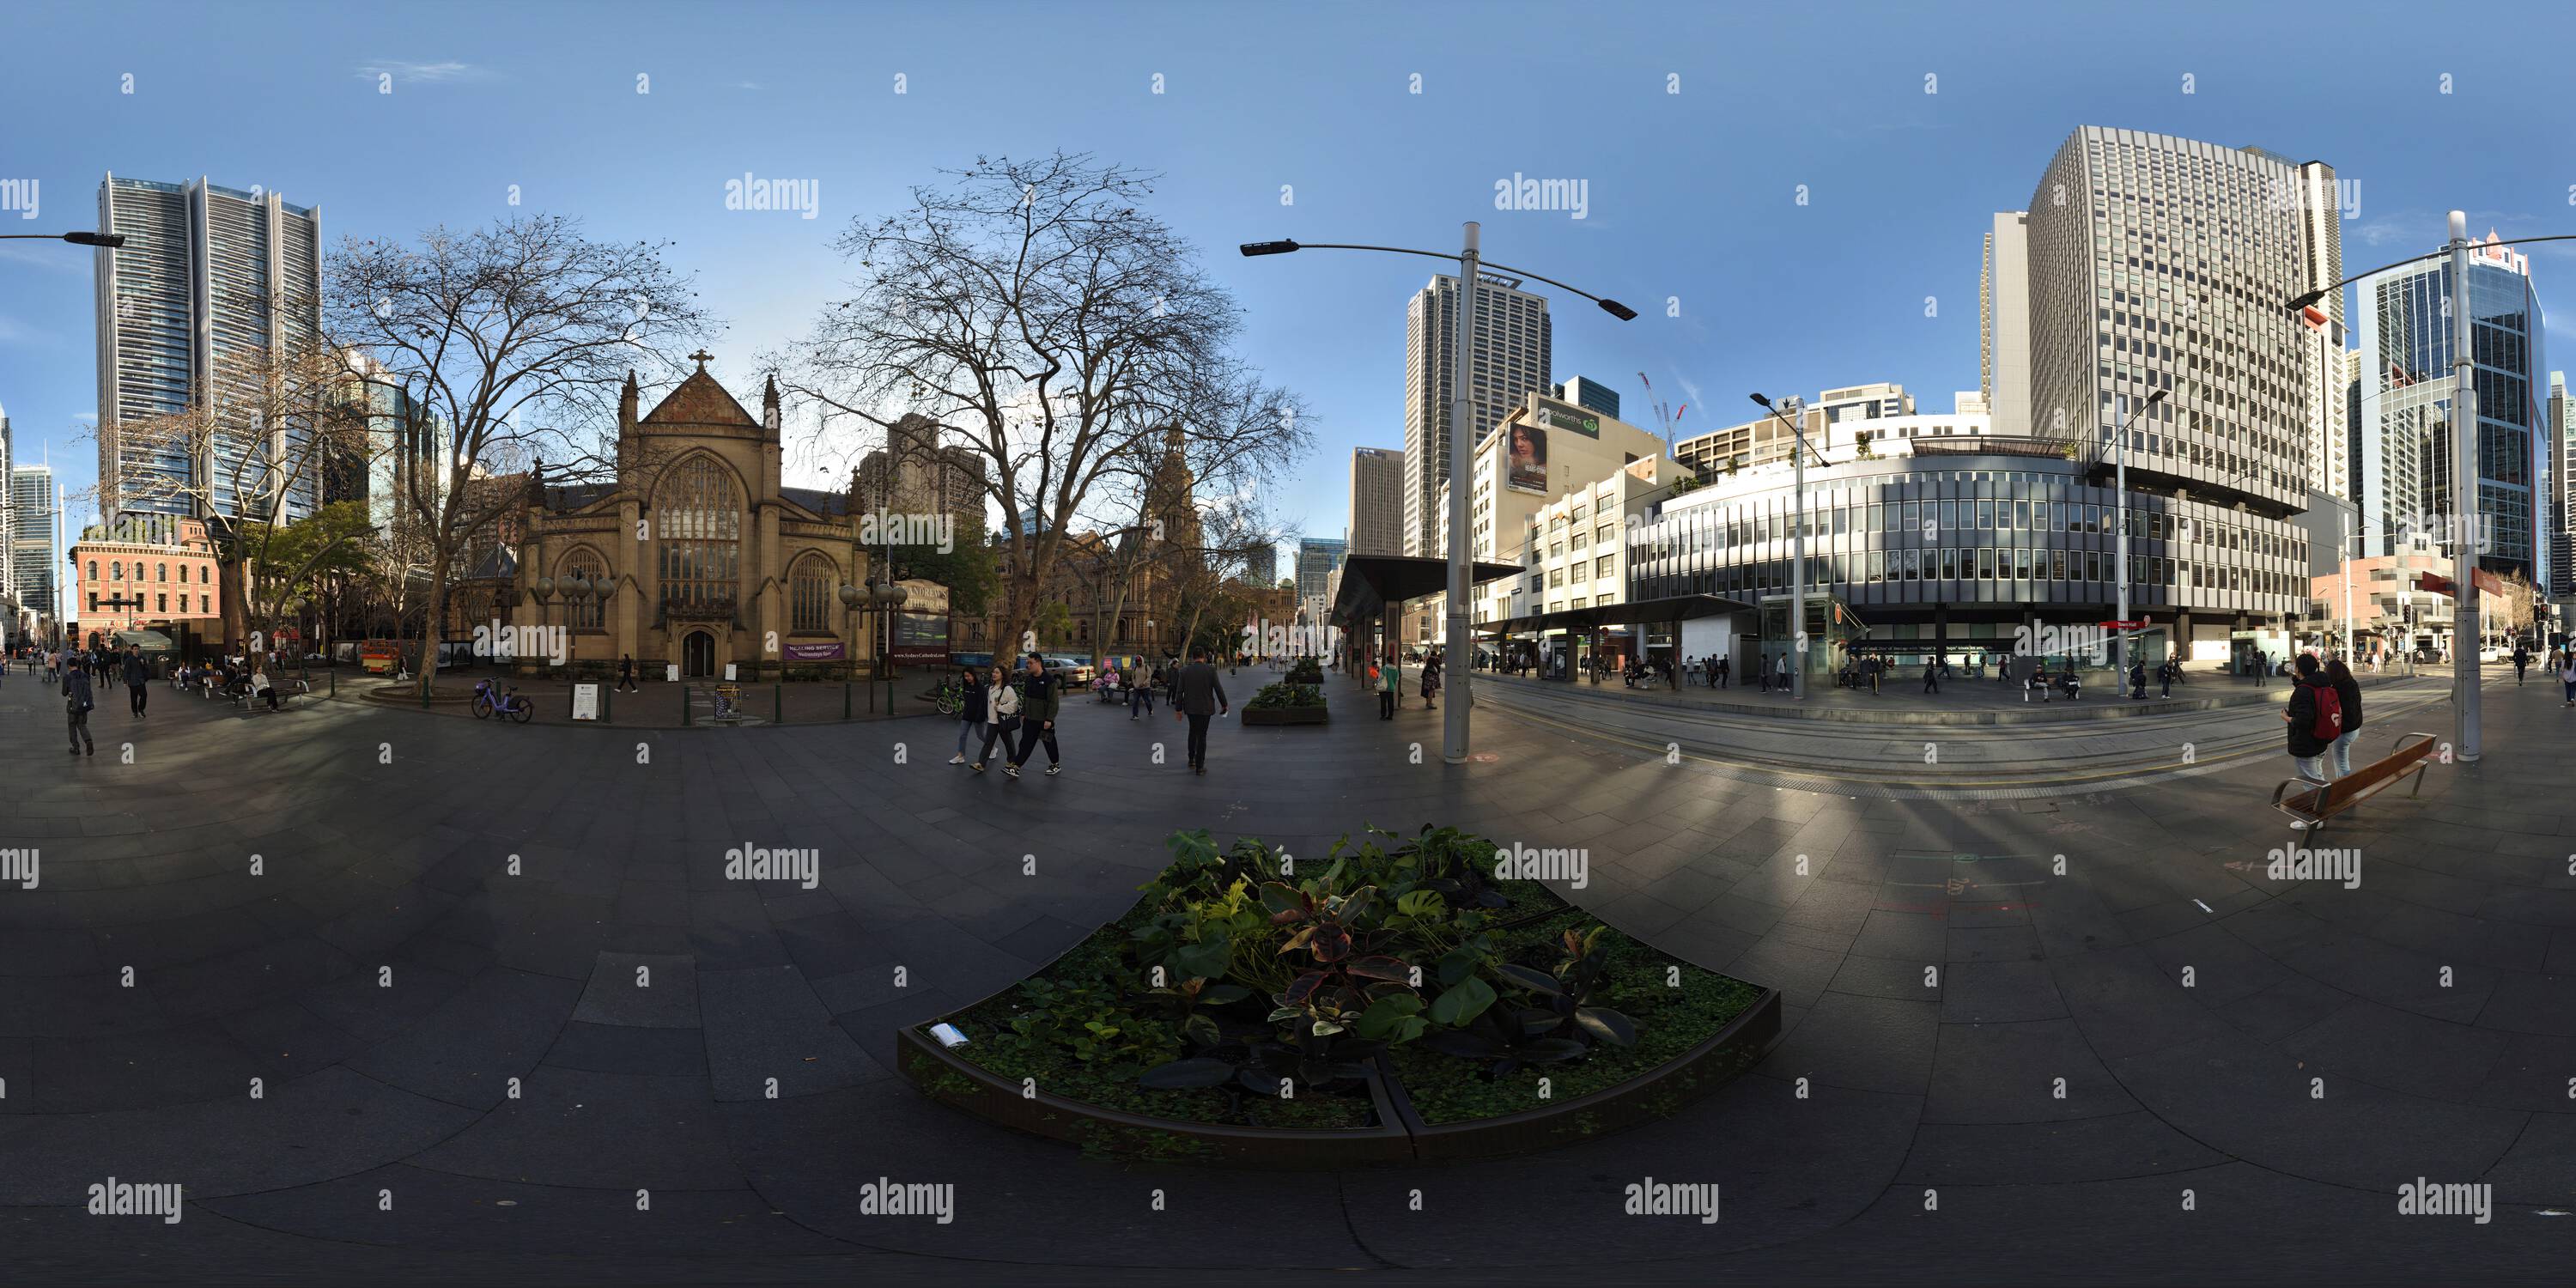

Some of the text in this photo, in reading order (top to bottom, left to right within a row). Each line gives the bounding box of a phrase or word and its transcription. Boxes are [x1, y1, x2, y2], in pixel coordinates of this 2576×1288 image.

[1539, 406, 1582, 424] woolworths
[907, 586, 947, 598] ANDREW'S
[905, 598, 945, 610] ATHEDRAL
